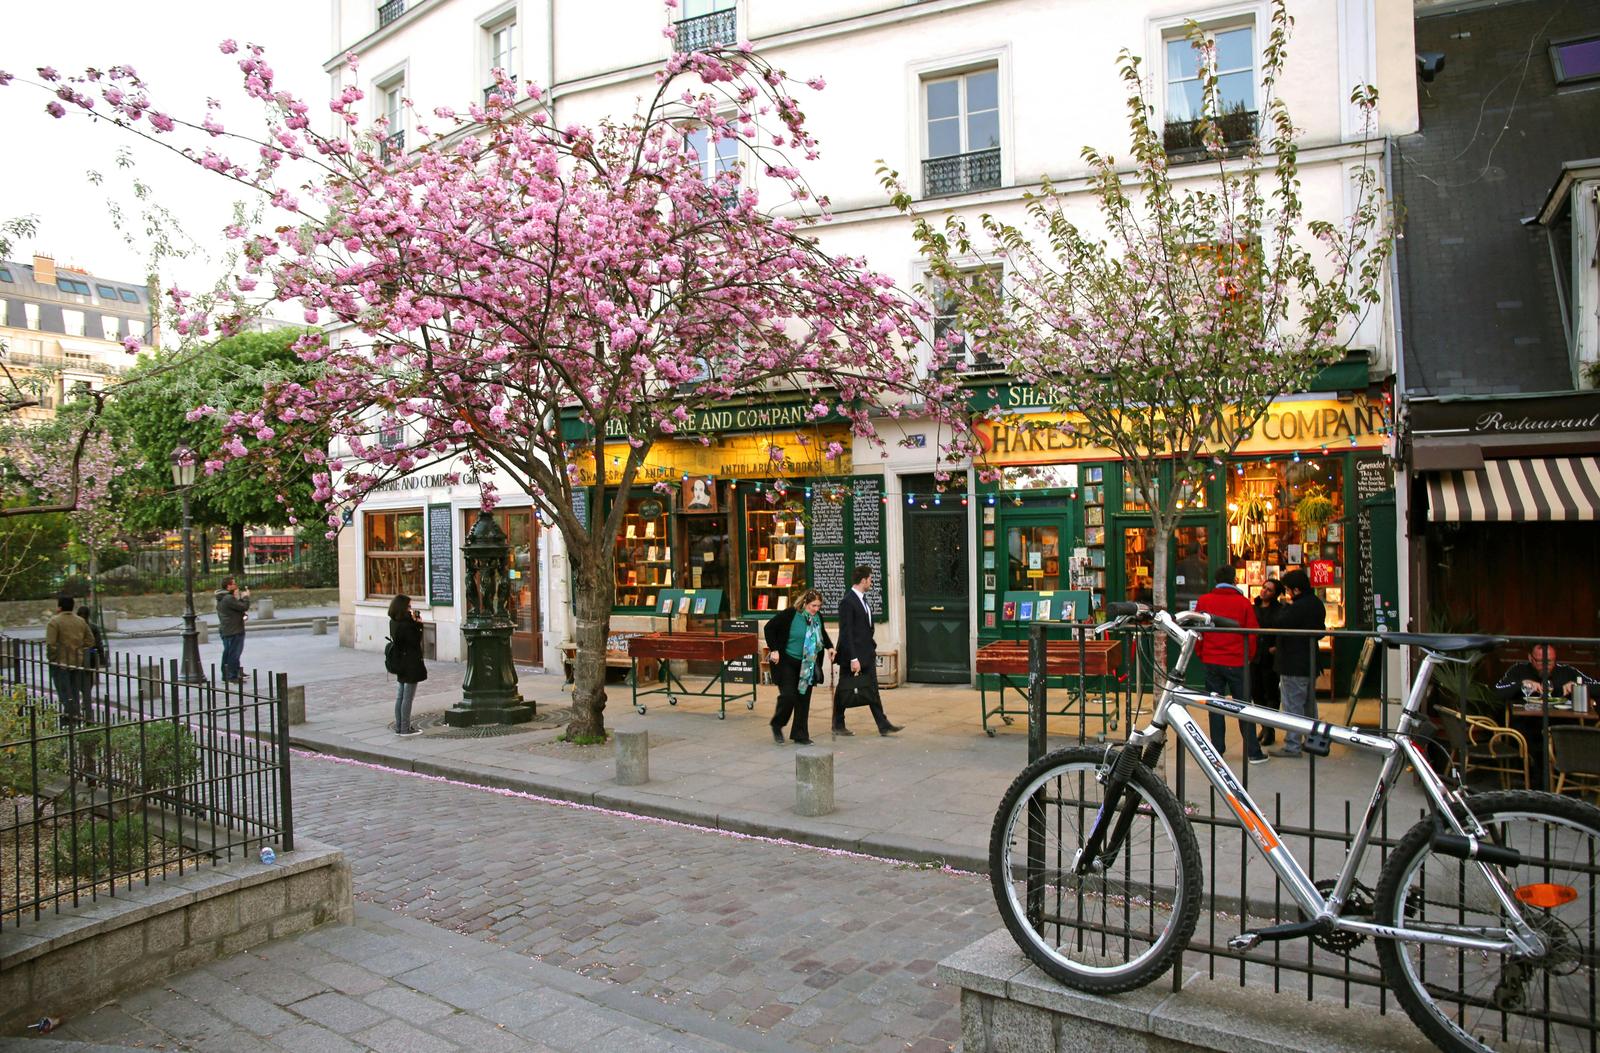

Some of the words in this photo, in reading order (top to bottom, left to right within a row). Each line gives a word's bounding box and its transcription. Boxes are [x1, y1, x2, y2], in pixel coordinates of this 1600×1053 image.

[701, 411, 732, 430] AND
[1475, 411, 1600, 431] Restaurant
[401, 477, 419, 490] AND
[1314, 562, 1329, 570] NEW
